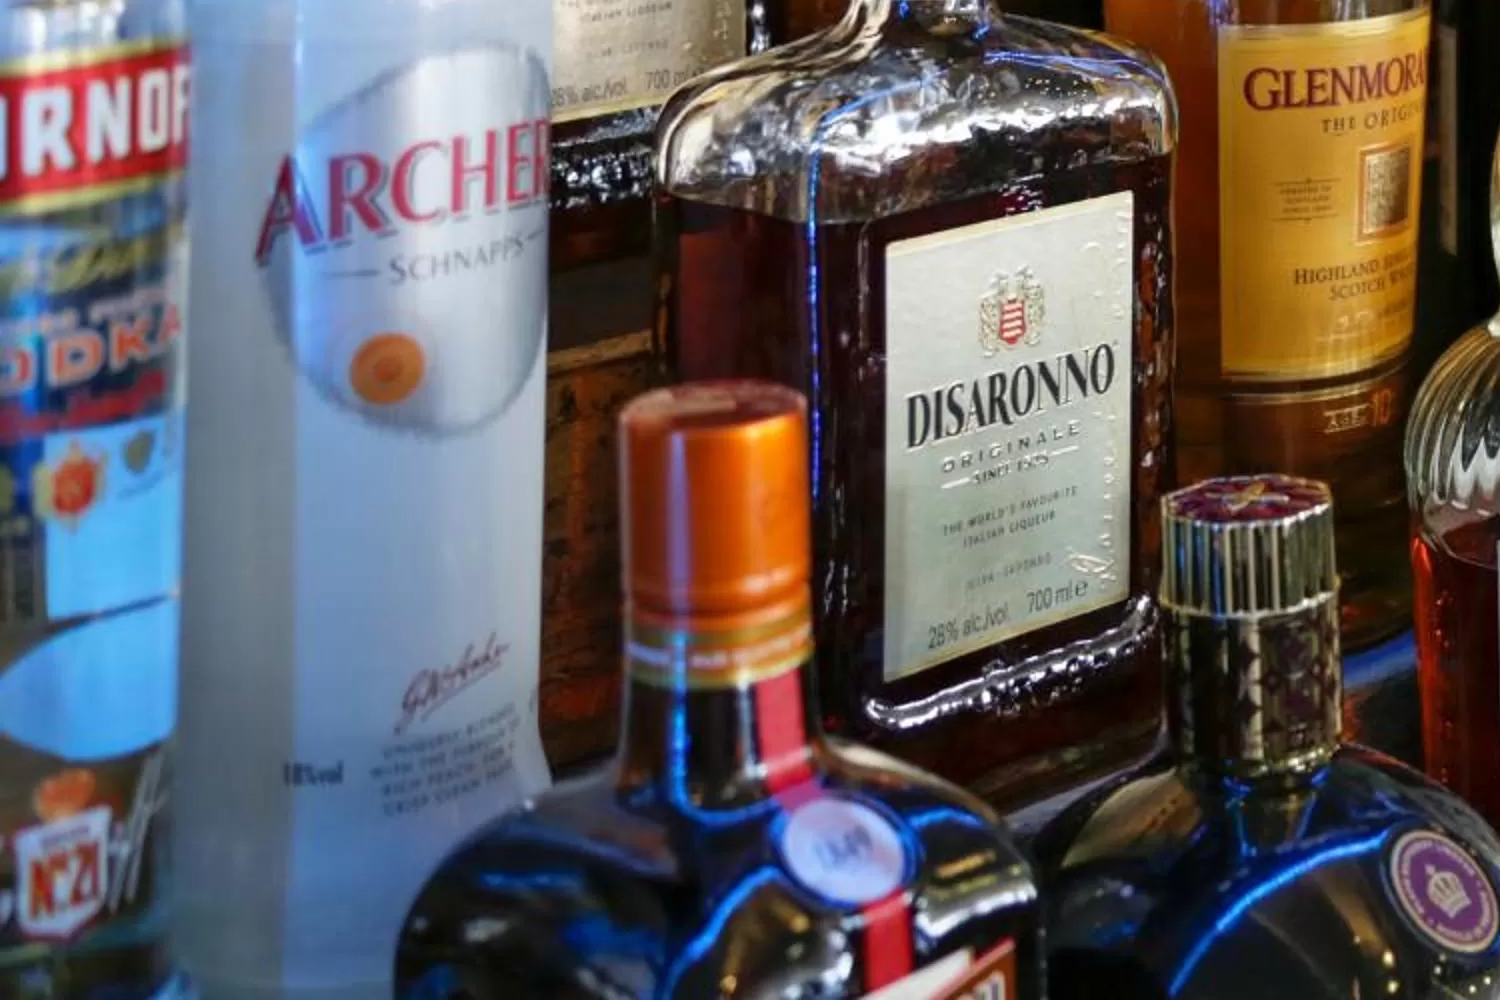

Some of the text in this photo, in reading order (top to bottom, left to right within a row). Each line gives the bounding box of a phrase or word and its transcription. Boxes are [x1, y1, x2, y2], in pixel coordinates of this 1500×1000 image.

[388, 236, 525, 286] SCHNAPPS
[1293, 258, 1381, 286] HIGHLAND
[906, 343, 1116, 449] DISARONNO
[942, 422, 1081, 473] ORIGINALE
[927, 617, 960, 651] 28%
[1025, 584, 1053, 615] 700
